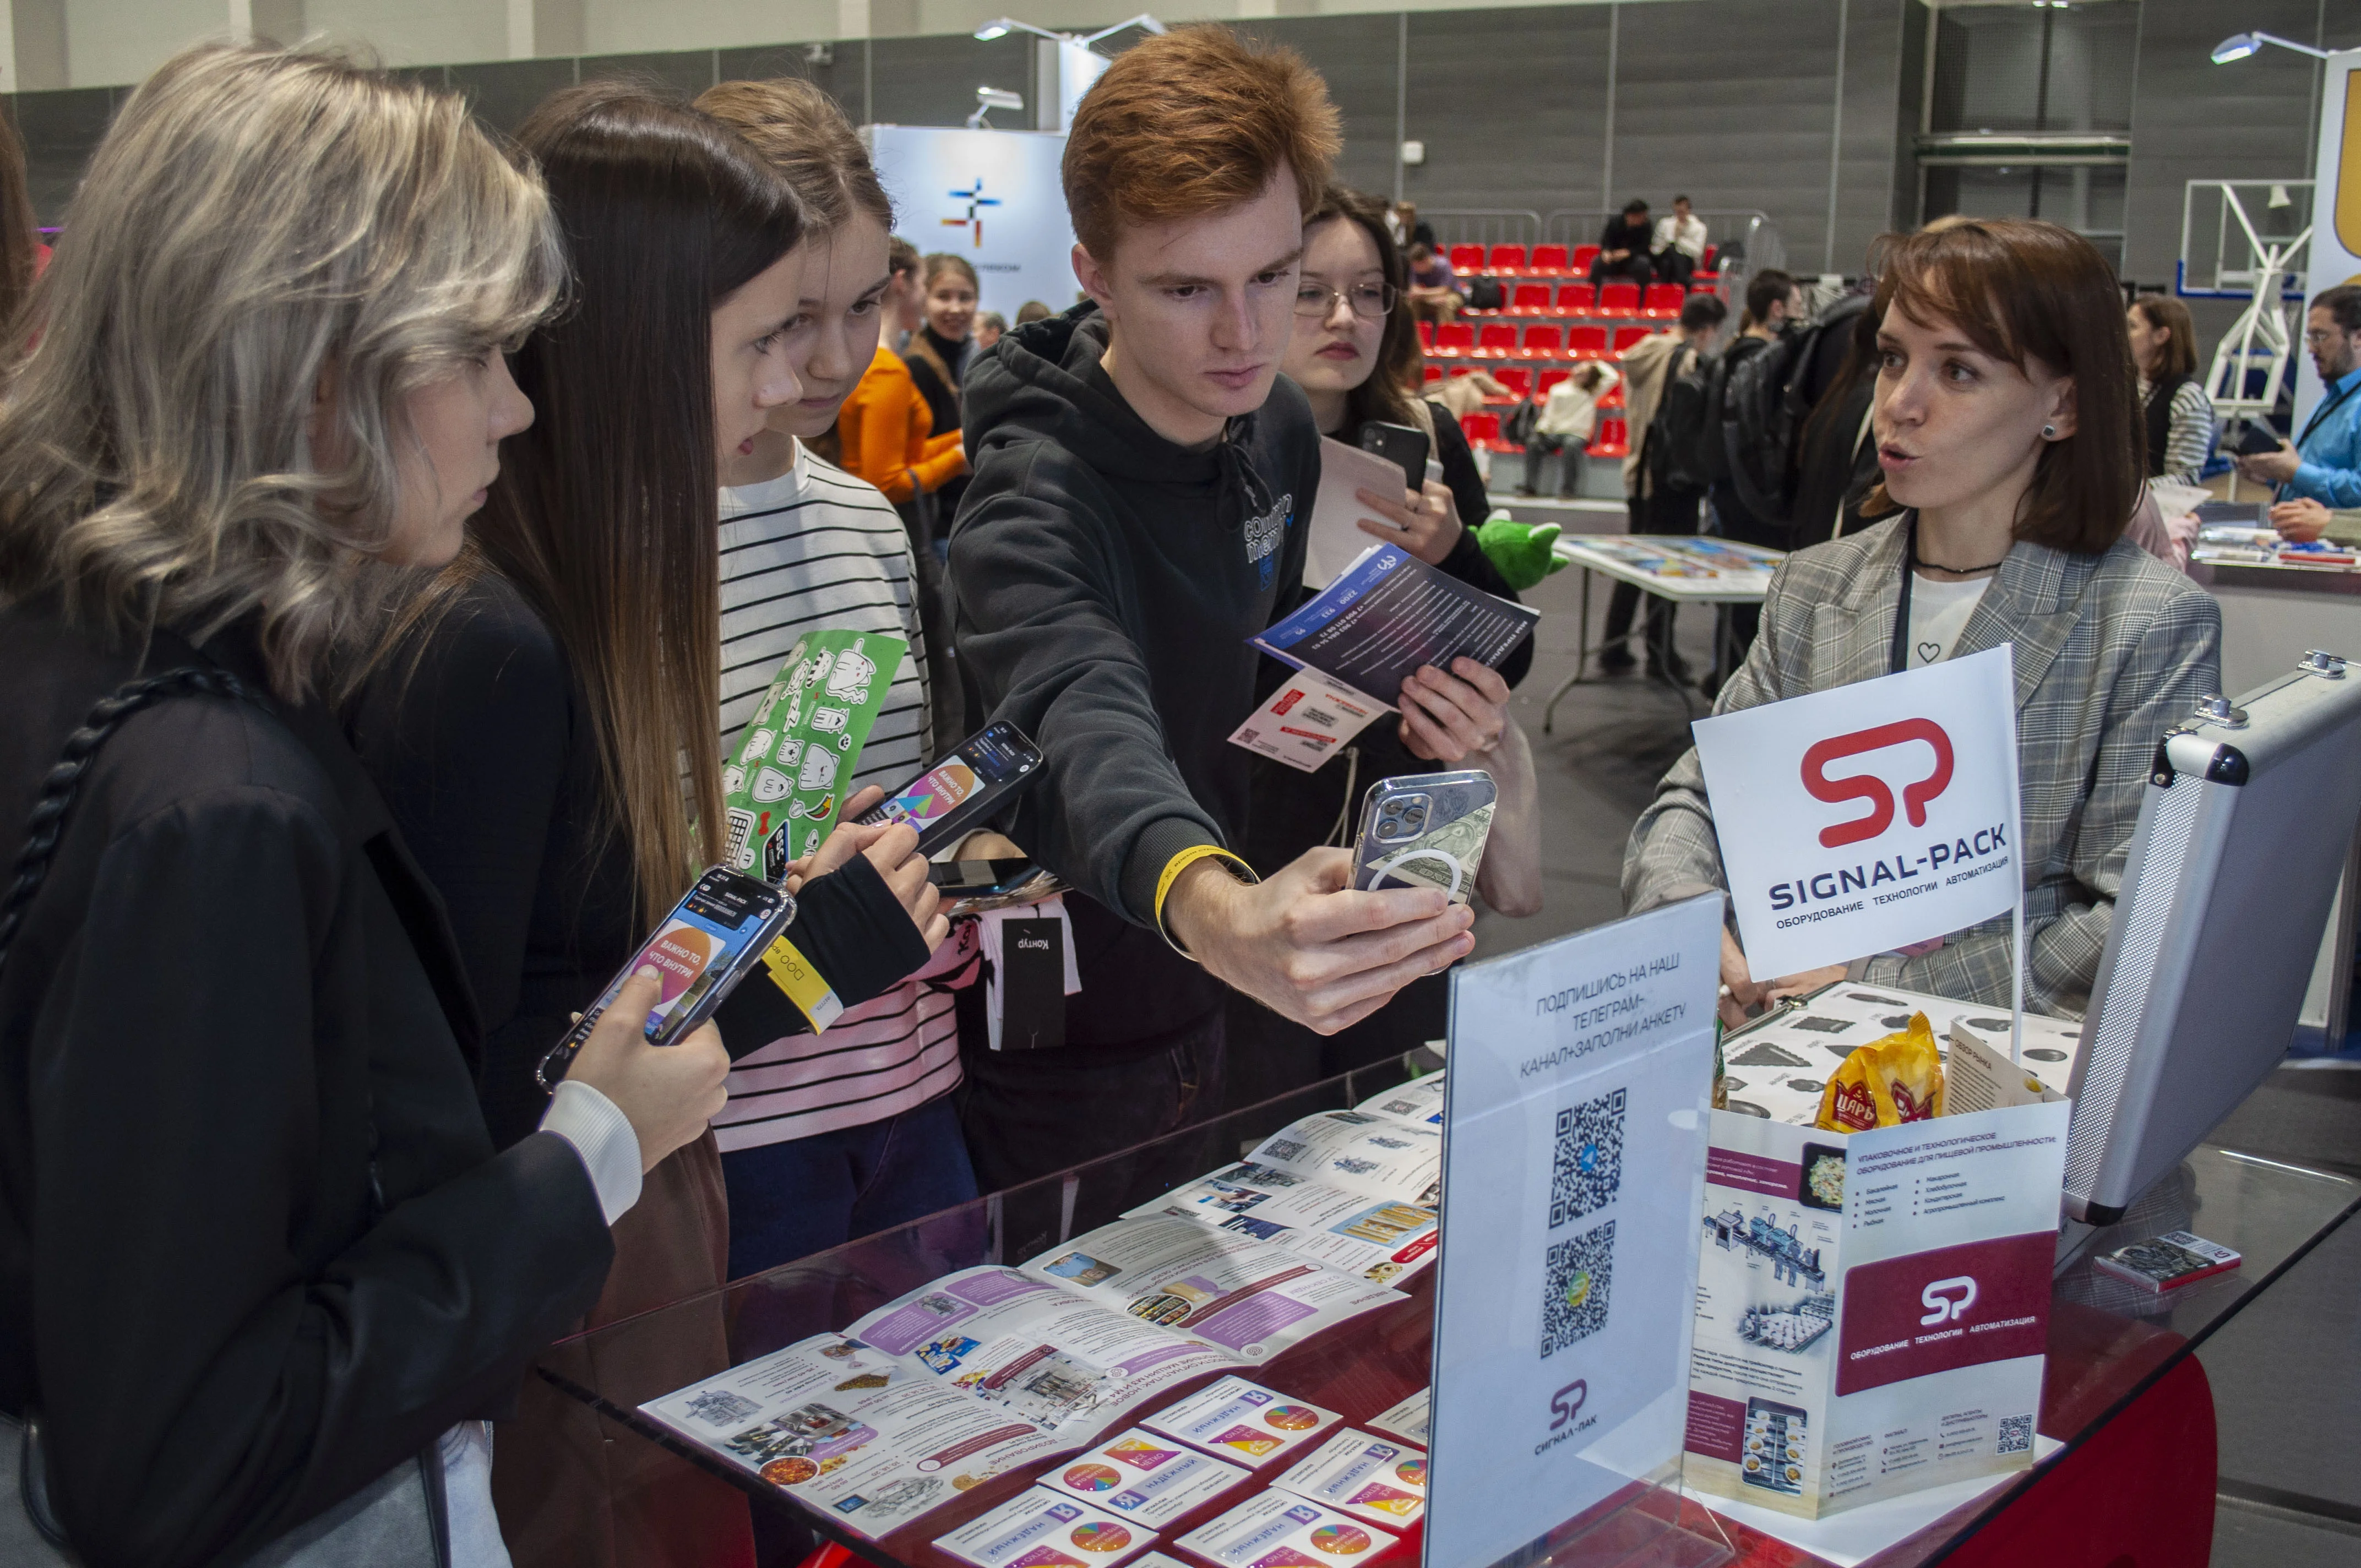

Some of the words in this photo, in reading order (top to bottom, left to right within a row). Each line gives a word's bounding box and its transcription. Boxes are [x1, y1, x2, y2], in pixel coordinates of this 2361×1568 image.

[928, 775, 938, 787] ЧТО
[935, 785, 956, 805] ВНУТРИ
[939, 770, 957, 788] ВАЖНО
[955, 785, 965, 797] ТО,
[743, 854, 752, 864] IT
[776, 829, 784, 861] esc
[1769, 823, 2007, 911] SIGNAL-PACK
[1776, 901, 1864, 929] ОБОРУДОВАНИЕ
[1872, 881, 1938, 906] ТЕХНОЛОГИИ
[1945, 856, 2009, 886] АВТОМАТИЗАЦИЯ
[661, 940, 689, 958] ВАЖНО
[688, 952, 701, 965] ТО,
[1018, 939, 1049, 950] Контур
[649, 950, 665, 963] ЧТО
[663, 959, 694, 978] ВНУТРИ
[1536, 973, 1626, 1016] ПОДПИШИСЬ
[1629, 965, 1647, 982] НА
[1650, 952, 1679, 977] НАШ
[1573, 994, 1645, 1031] ТЕЛЕГРАМ-
[1520, 1020, 1638, 1079] КАНАЛ+ЗАПОЛНИ
[1639, 1003, 1687, 1034] АНКЕТУ
[1955, 1039, 1973, 1057] ОБЗОР
[1973, 1051, 1993, 1071] РЫНКА
[1836, 1095, 1873, 1120] ЦАРЬ
[1857, 1146, 1913, 1163] УПАКОВОЧНОЕ
[1922, 1132, 1996, 1151] ТЕХНОЛОГИЧЕСКОЕ
[1857, 1157, 1917, 1175] ОБОРУДОВАНИЕ
[1918, 1154, 1933, 1164] ДЛЯ
[1934, 1146, 1975, 1161] ПИЩЕВОЙ
[1350, 1291, 1388, 1305] ВВЕДЕНИЕ
[1850, 1339, 1909, 1360] ОБОРУДОВАНИЕ
[1915, 1327, 1963, 1344] ТЕХНОЛОГИИ
[1969, 1316, 2036, 1333] АВТОМАТИЗАЦИЯ
[1145, 1361, 1178, 1380] МАШИН
[1110, 1385, 1144, 1407] НОВОЕ
[1535, 1414, 1597, 1456] СИГНАЛ-ПАК
[988, 1439, 1058, 1466] ДОЗИРОВАНИЕ
